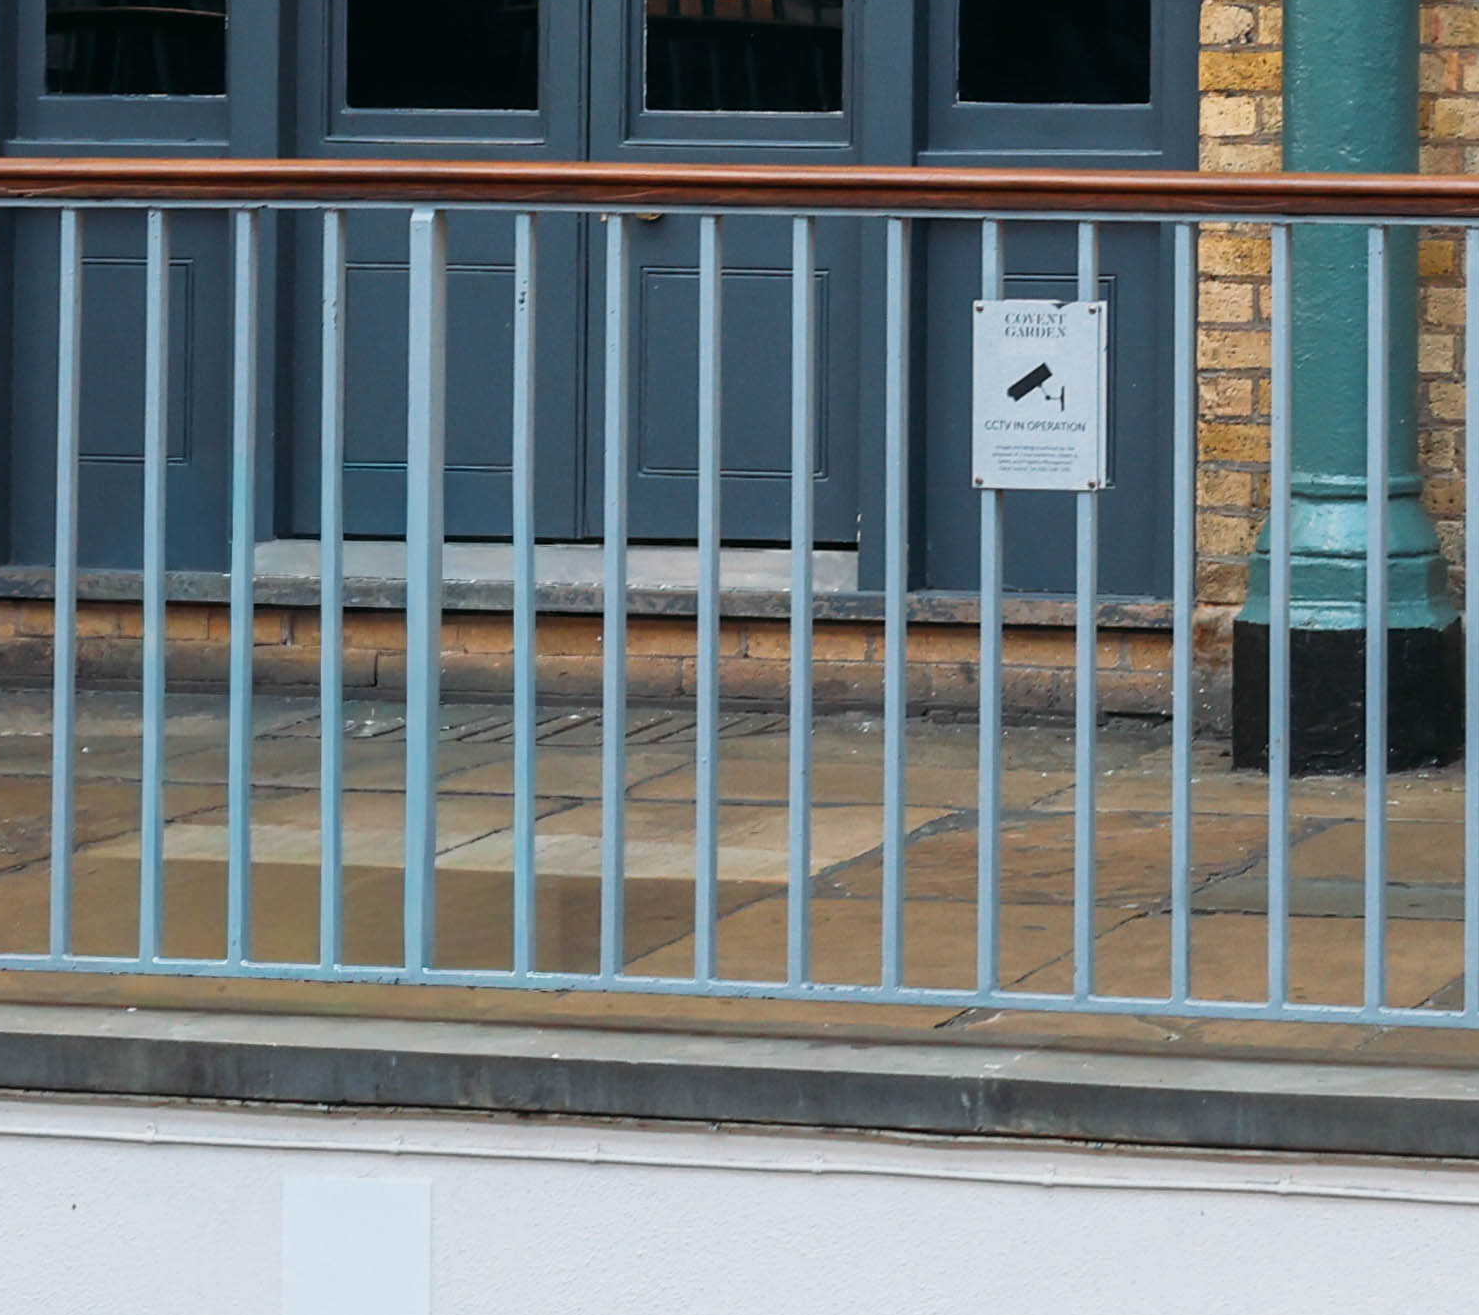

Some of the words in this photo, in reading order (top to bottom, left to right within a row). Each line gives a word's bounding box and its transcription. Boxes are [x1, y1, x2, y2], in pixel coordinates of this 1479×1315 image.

[1004, 312, 1067, 324] COVENT
[1004, 326, 1067, 338] GARDEN
[984, 419, 1013, 431] CCTV
[1013, 420, 1025, 431] IN
[1027, 420, 1087, 432] OPERATION
